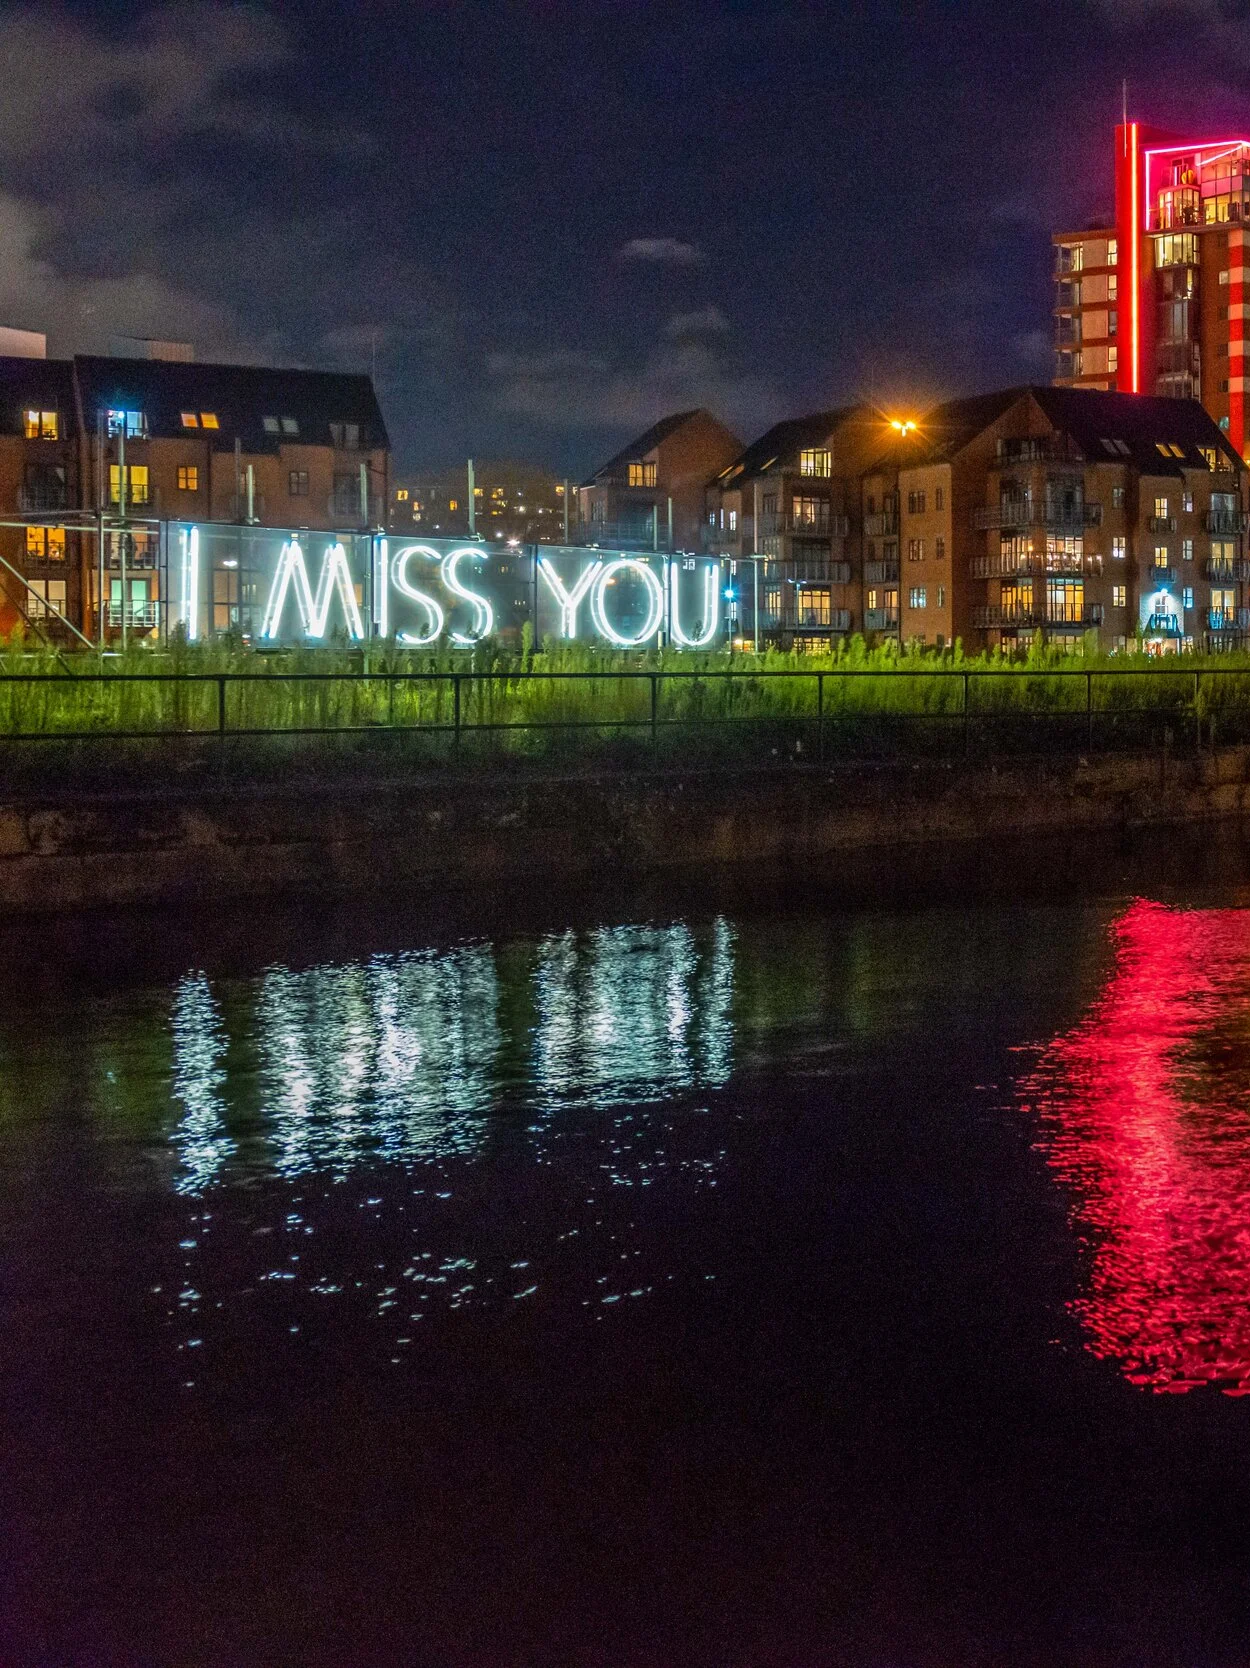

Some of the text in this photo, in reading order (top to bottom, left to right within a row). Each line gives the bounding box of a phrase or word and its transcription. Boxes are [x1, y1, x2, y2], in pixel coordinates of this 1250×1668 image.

[180, 526, 720, 646] I MISS YOU
